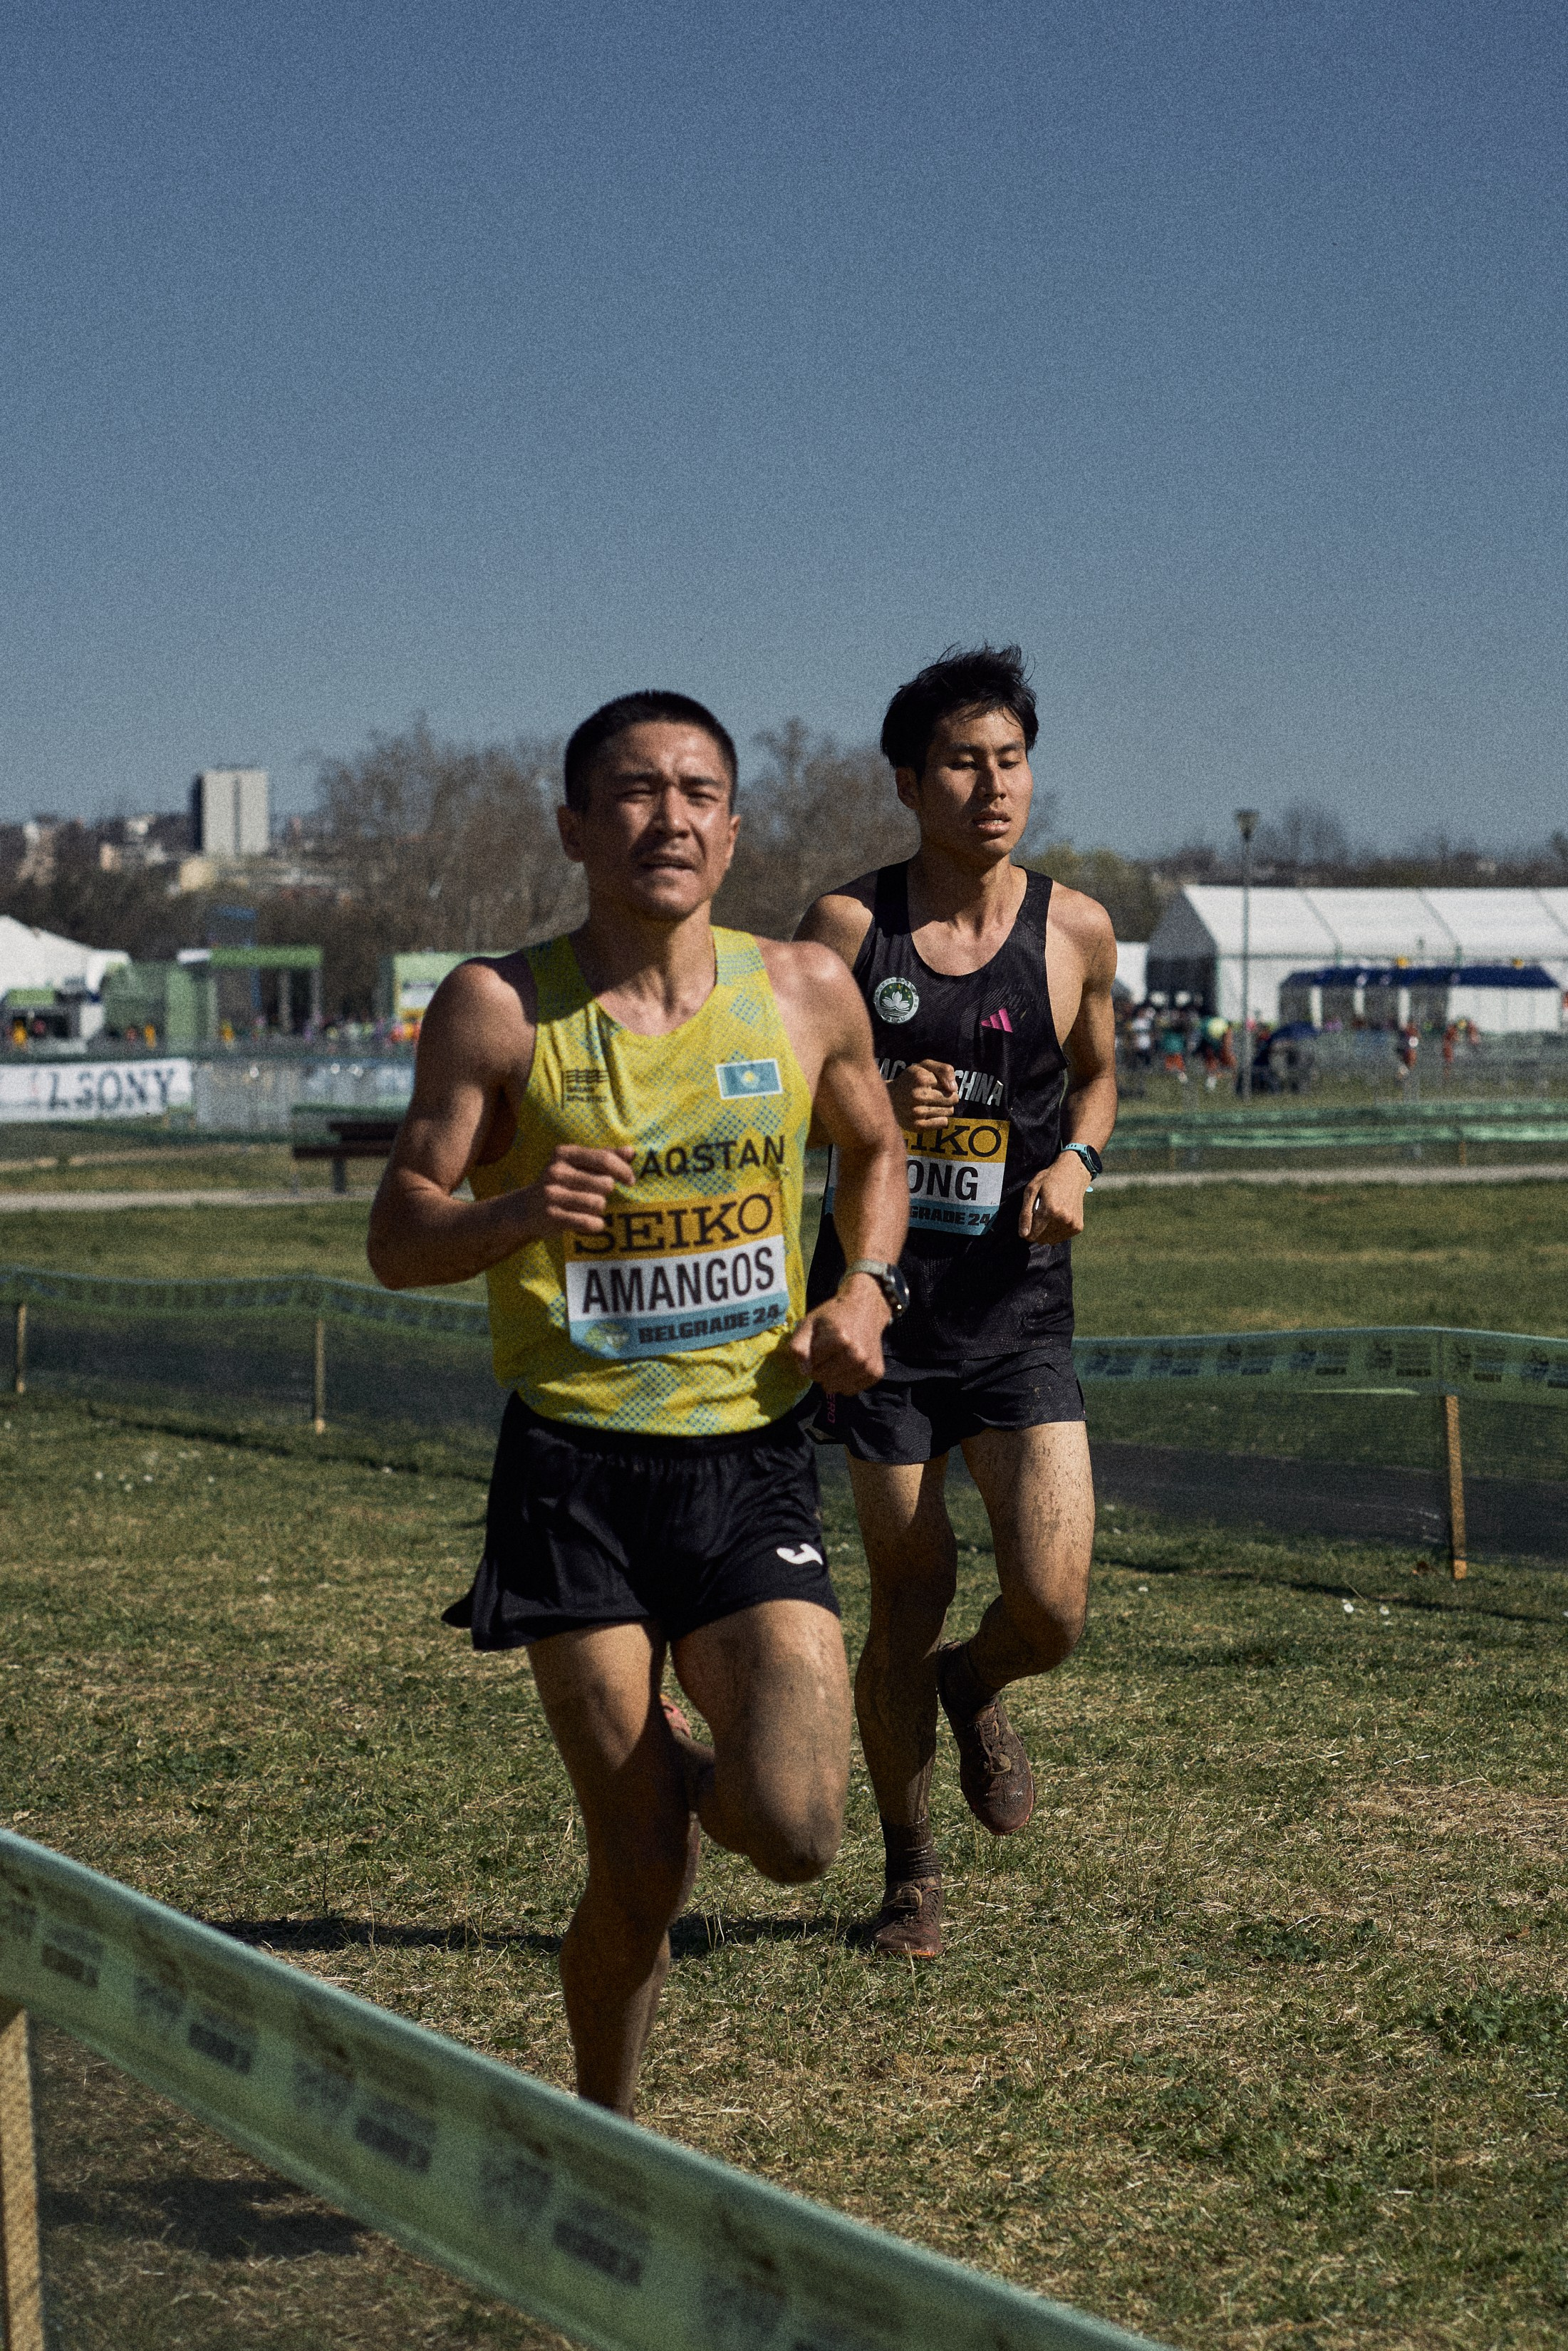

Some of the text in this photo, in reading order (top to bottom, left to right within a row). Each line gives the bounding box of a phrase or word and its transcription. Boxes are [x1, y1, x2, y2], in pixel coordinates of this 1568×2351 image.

[633, 1135, 784, 1178] AQSTAN
[906, 1125, 1002, 1158] IKO
[906, 1159, 979, 1201] ONG
[574, 1193, 773, 1255] SEIKO
[910, 1205, 991, 1226] GRADE 24
[582, 1246, 775, 1314] AMANGOS
[638, 1303, 781, 1344] BELGRADE 24
[826, 1391, 836, 1423] ERO
